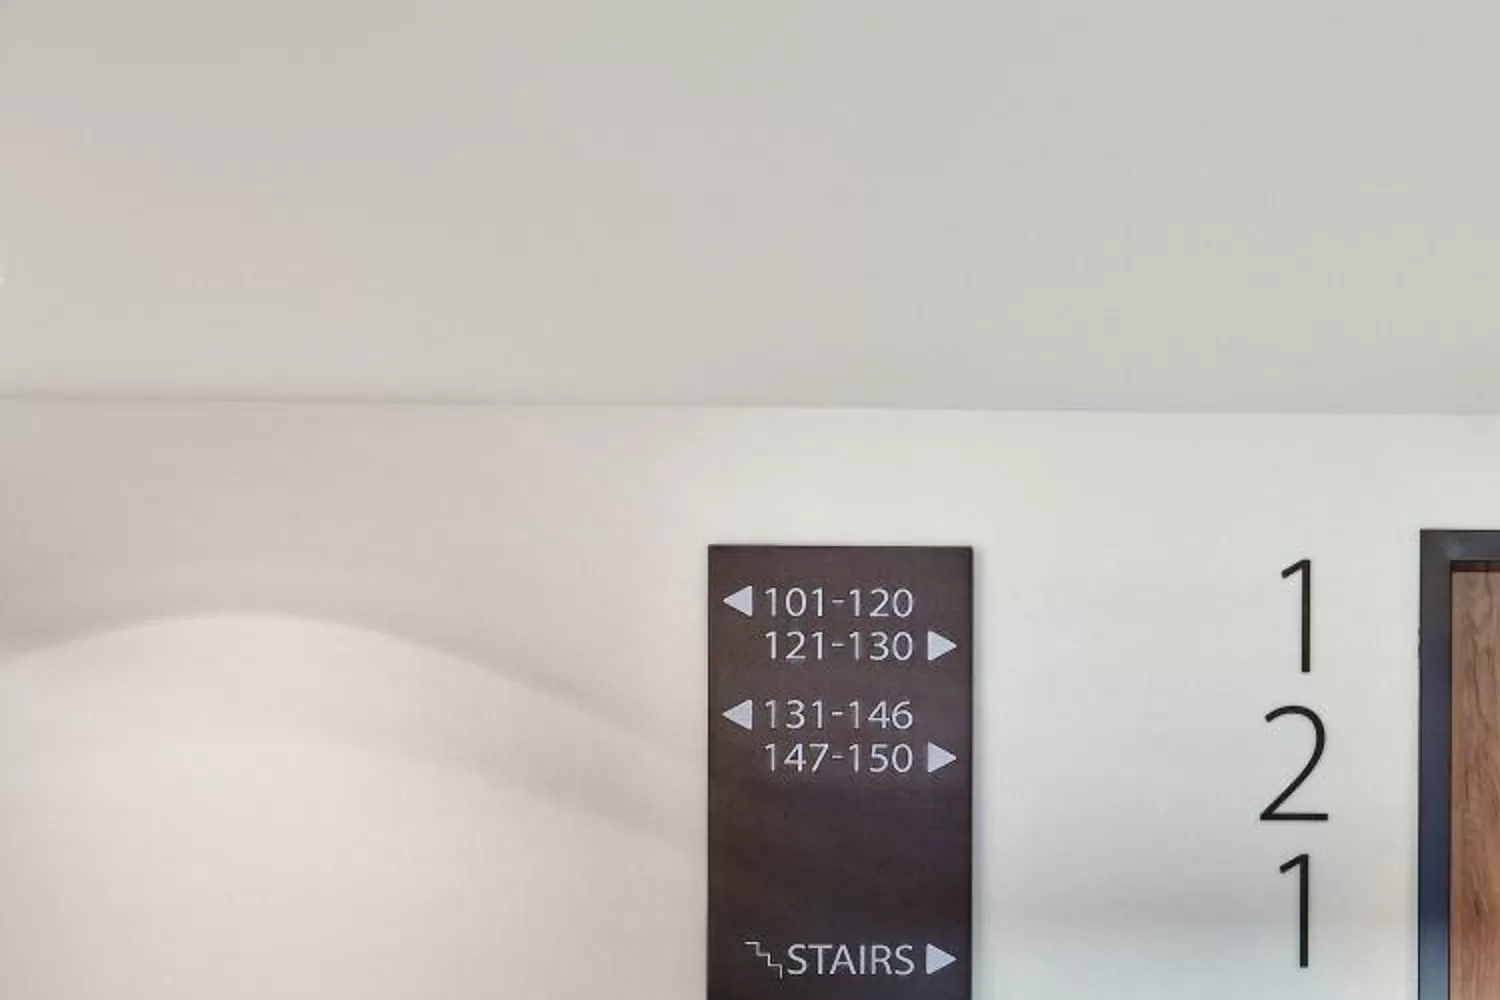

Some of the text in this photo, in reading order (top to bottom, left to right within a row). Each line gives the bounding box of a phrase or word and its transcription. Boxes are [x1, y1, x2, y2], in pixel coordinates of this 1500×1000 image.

[764, 587, 914, 618] 101-120
[764, 630, 914, 661] 121-130
[764, 699, 914, 730] 131-146
[764, 742, 914, 773] 147-150
[786, 943, 916, 976] STAIRS
